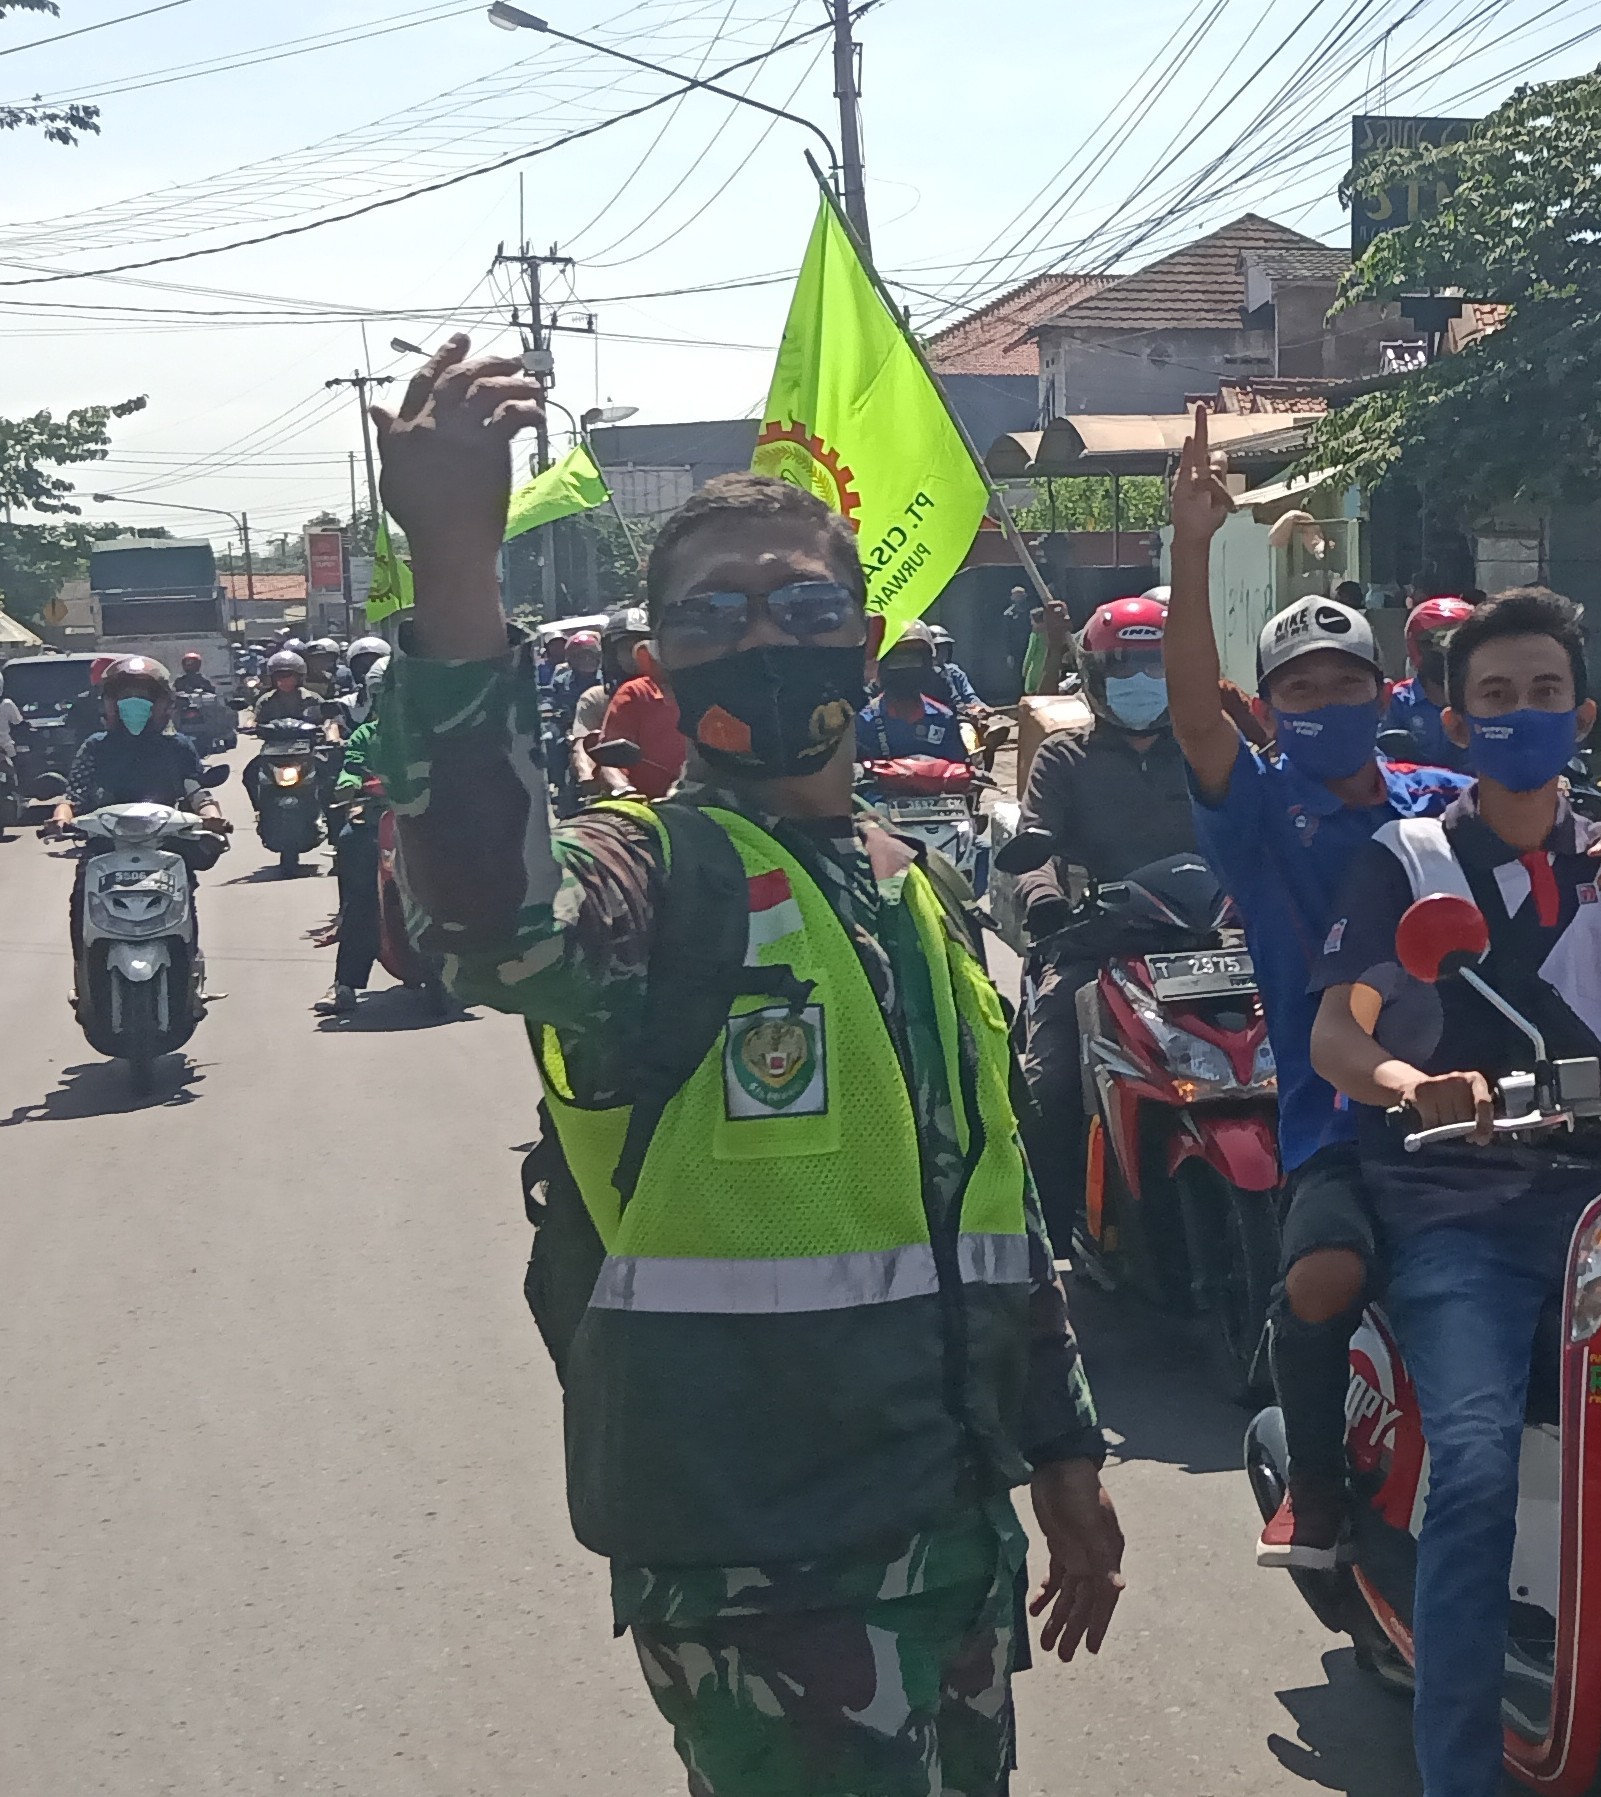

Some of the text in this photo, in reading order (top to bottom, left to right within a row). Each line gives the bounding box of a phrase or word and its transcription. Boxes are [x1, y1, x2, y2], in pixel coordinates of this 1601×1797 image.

[1121, 628, 1158, 636] INK
[1274, 606, 1309, 637] NIKE
[1155, 956, 1241, 978] T 2975
